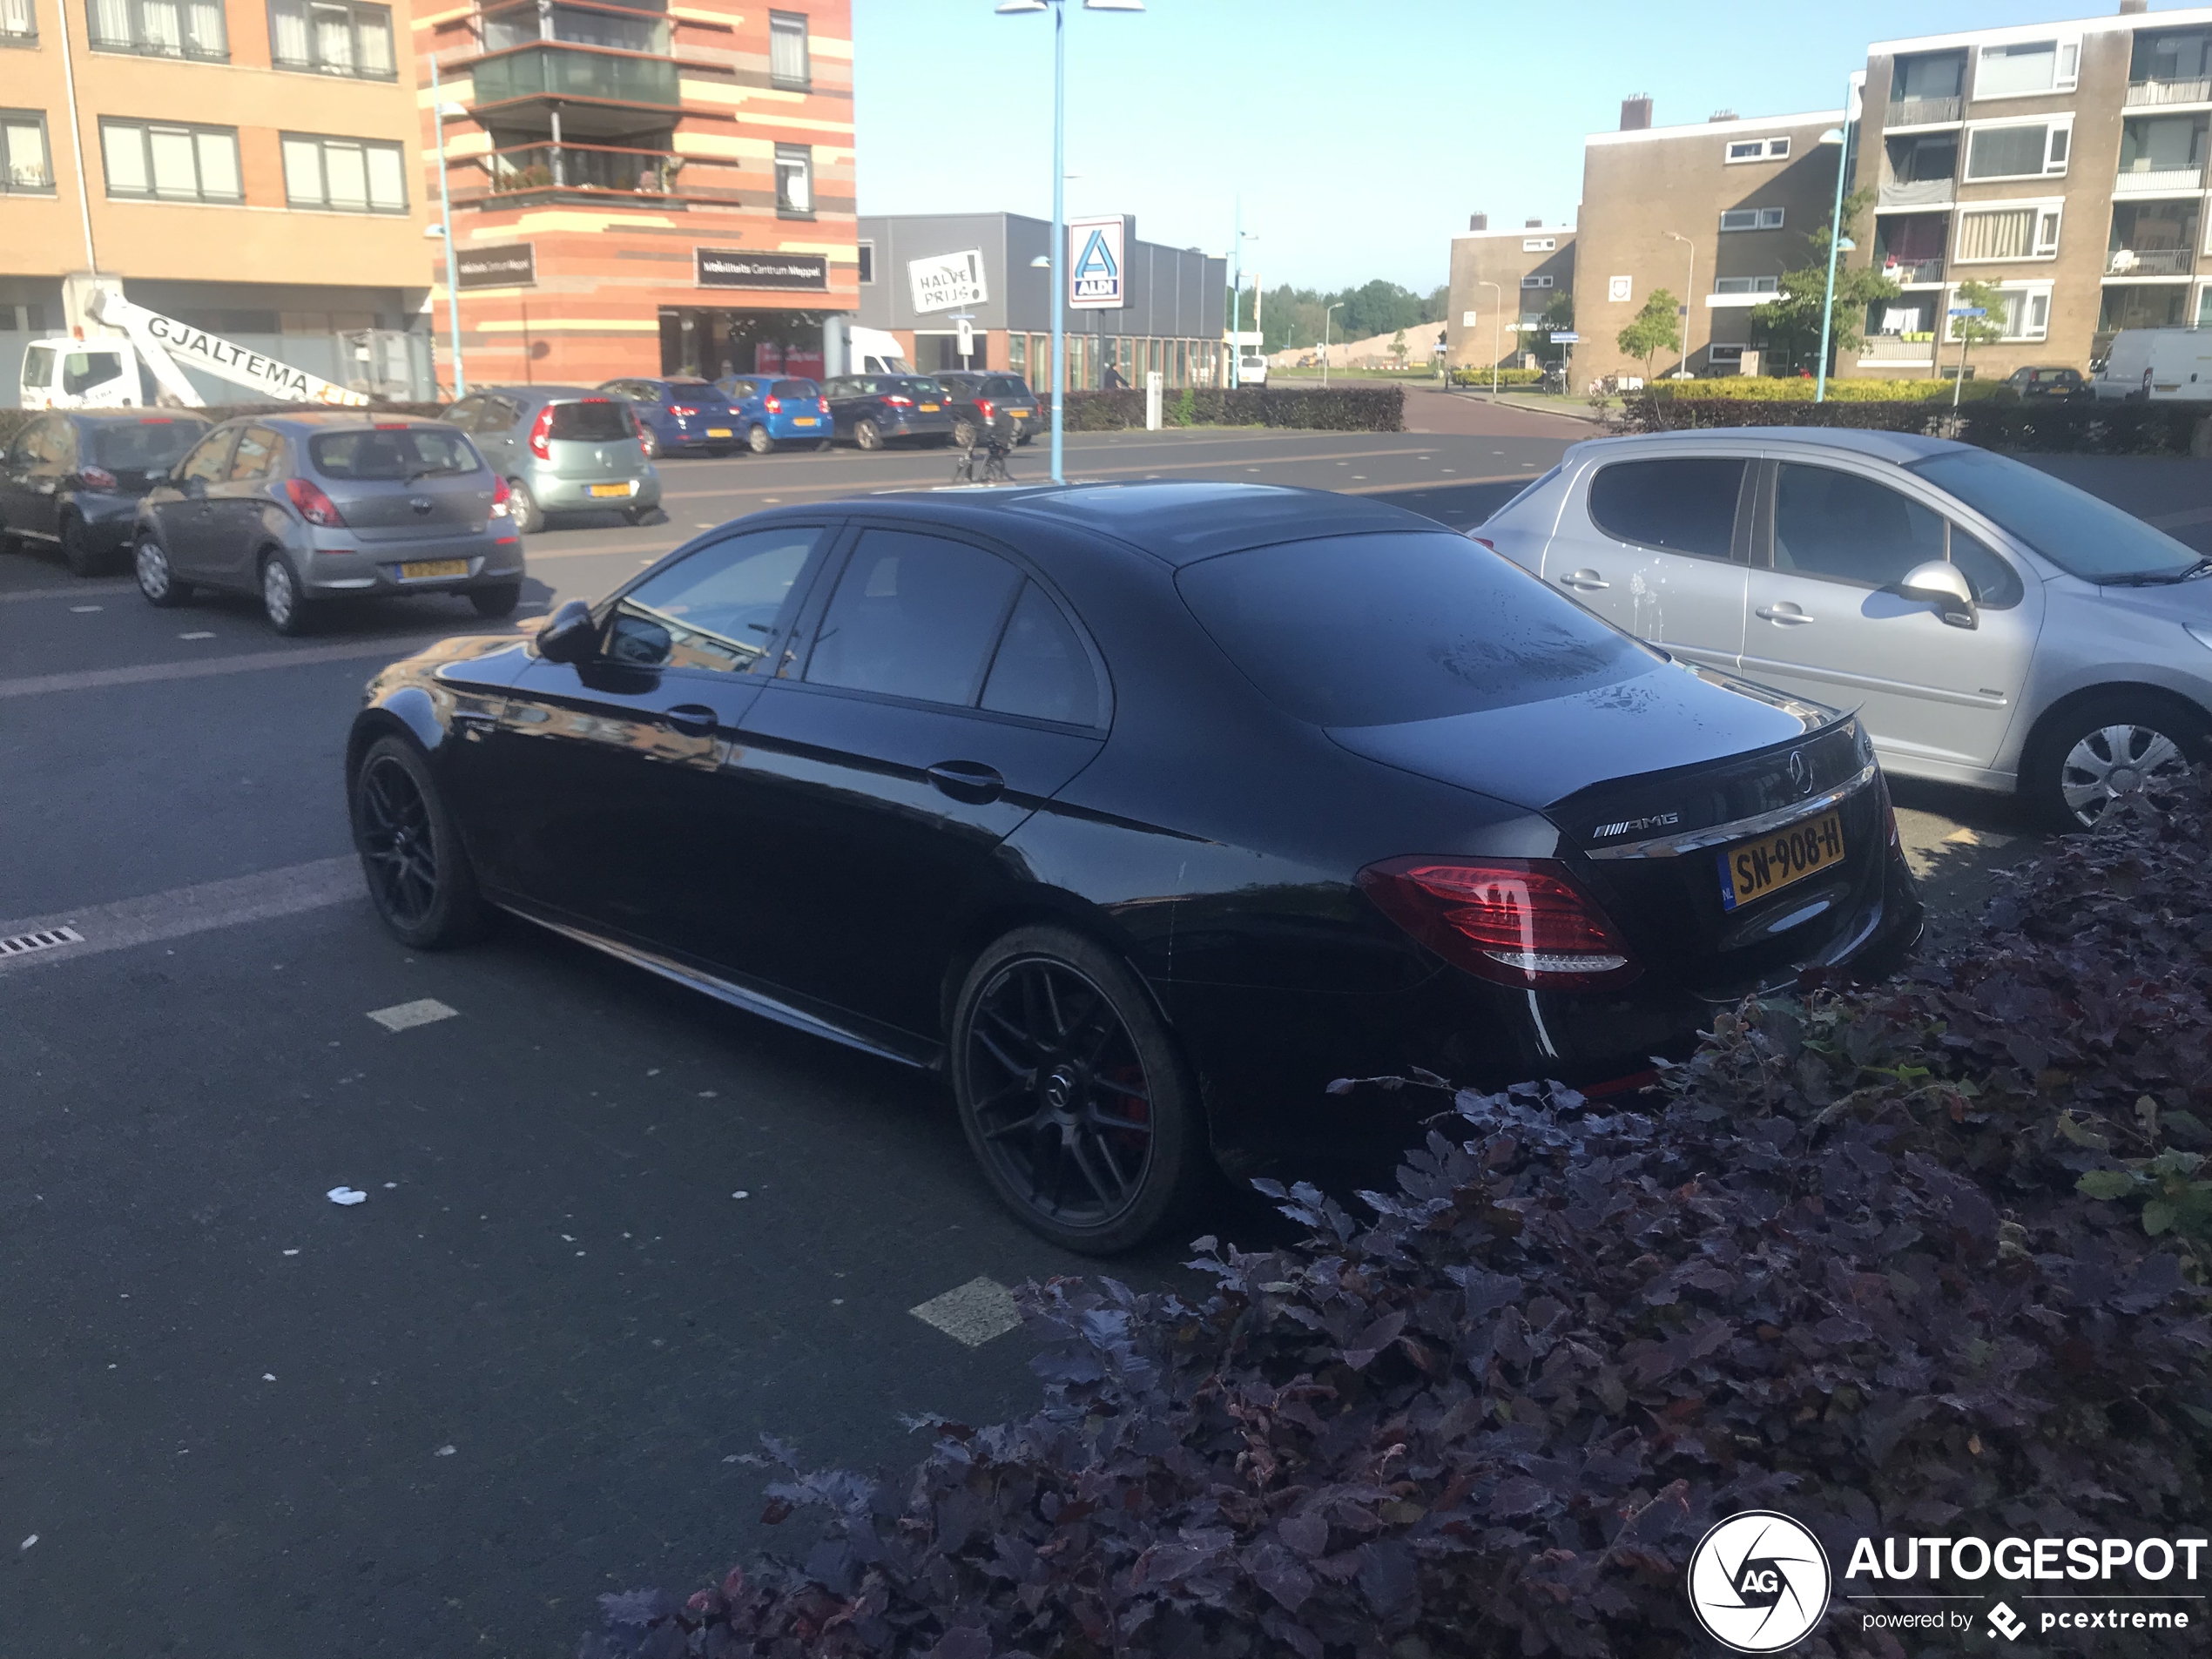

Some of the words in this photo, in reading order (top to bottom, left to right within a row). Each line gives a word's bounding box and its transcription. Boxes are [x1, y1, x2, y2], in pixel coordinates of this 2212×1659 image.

[920, 269, 968, 289] HALVE
[1077, 280, 1114, 295] ALDI
[147, 316, 308, 394] GJALTEMA
[1737, 817, 1841, 895] SN-908-H
[1722, 889, 1734, 901] NL
